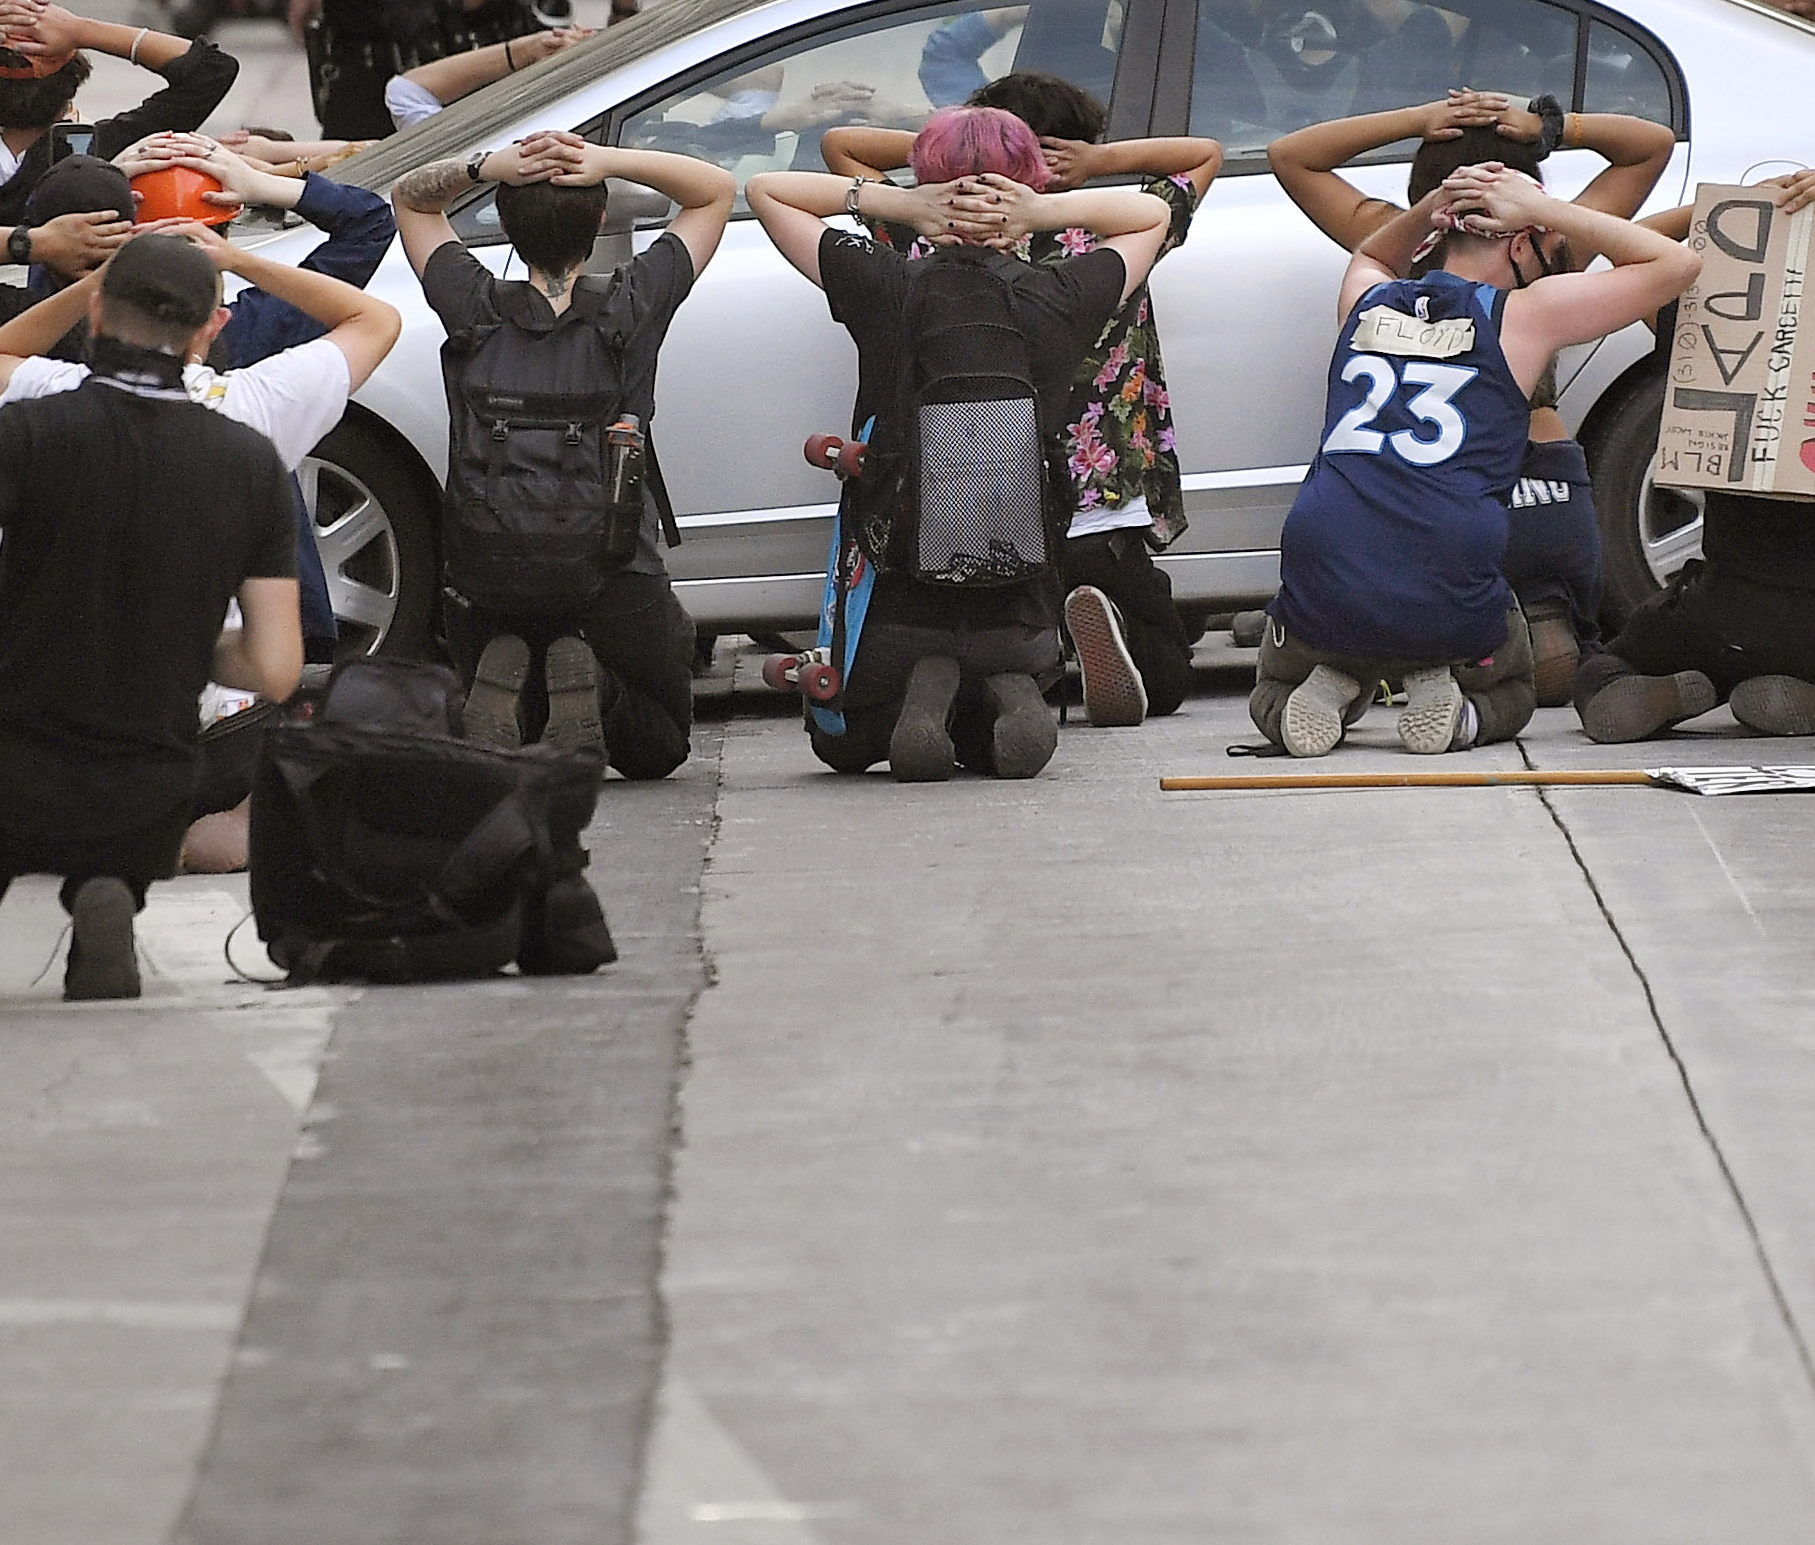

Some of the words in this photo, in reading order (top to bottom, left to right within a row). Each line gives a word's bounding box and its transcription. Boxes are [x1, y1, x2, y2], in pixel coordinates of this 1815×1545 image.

[1375, 316, 1465, 350] FLOYD
[1673, 200, 1774, 482] LAPD
[1322, 354, 1479, 467] 23
[1752, 385, 1788, 463] FUCK
[1660, 447, 1722, 476] BLM
